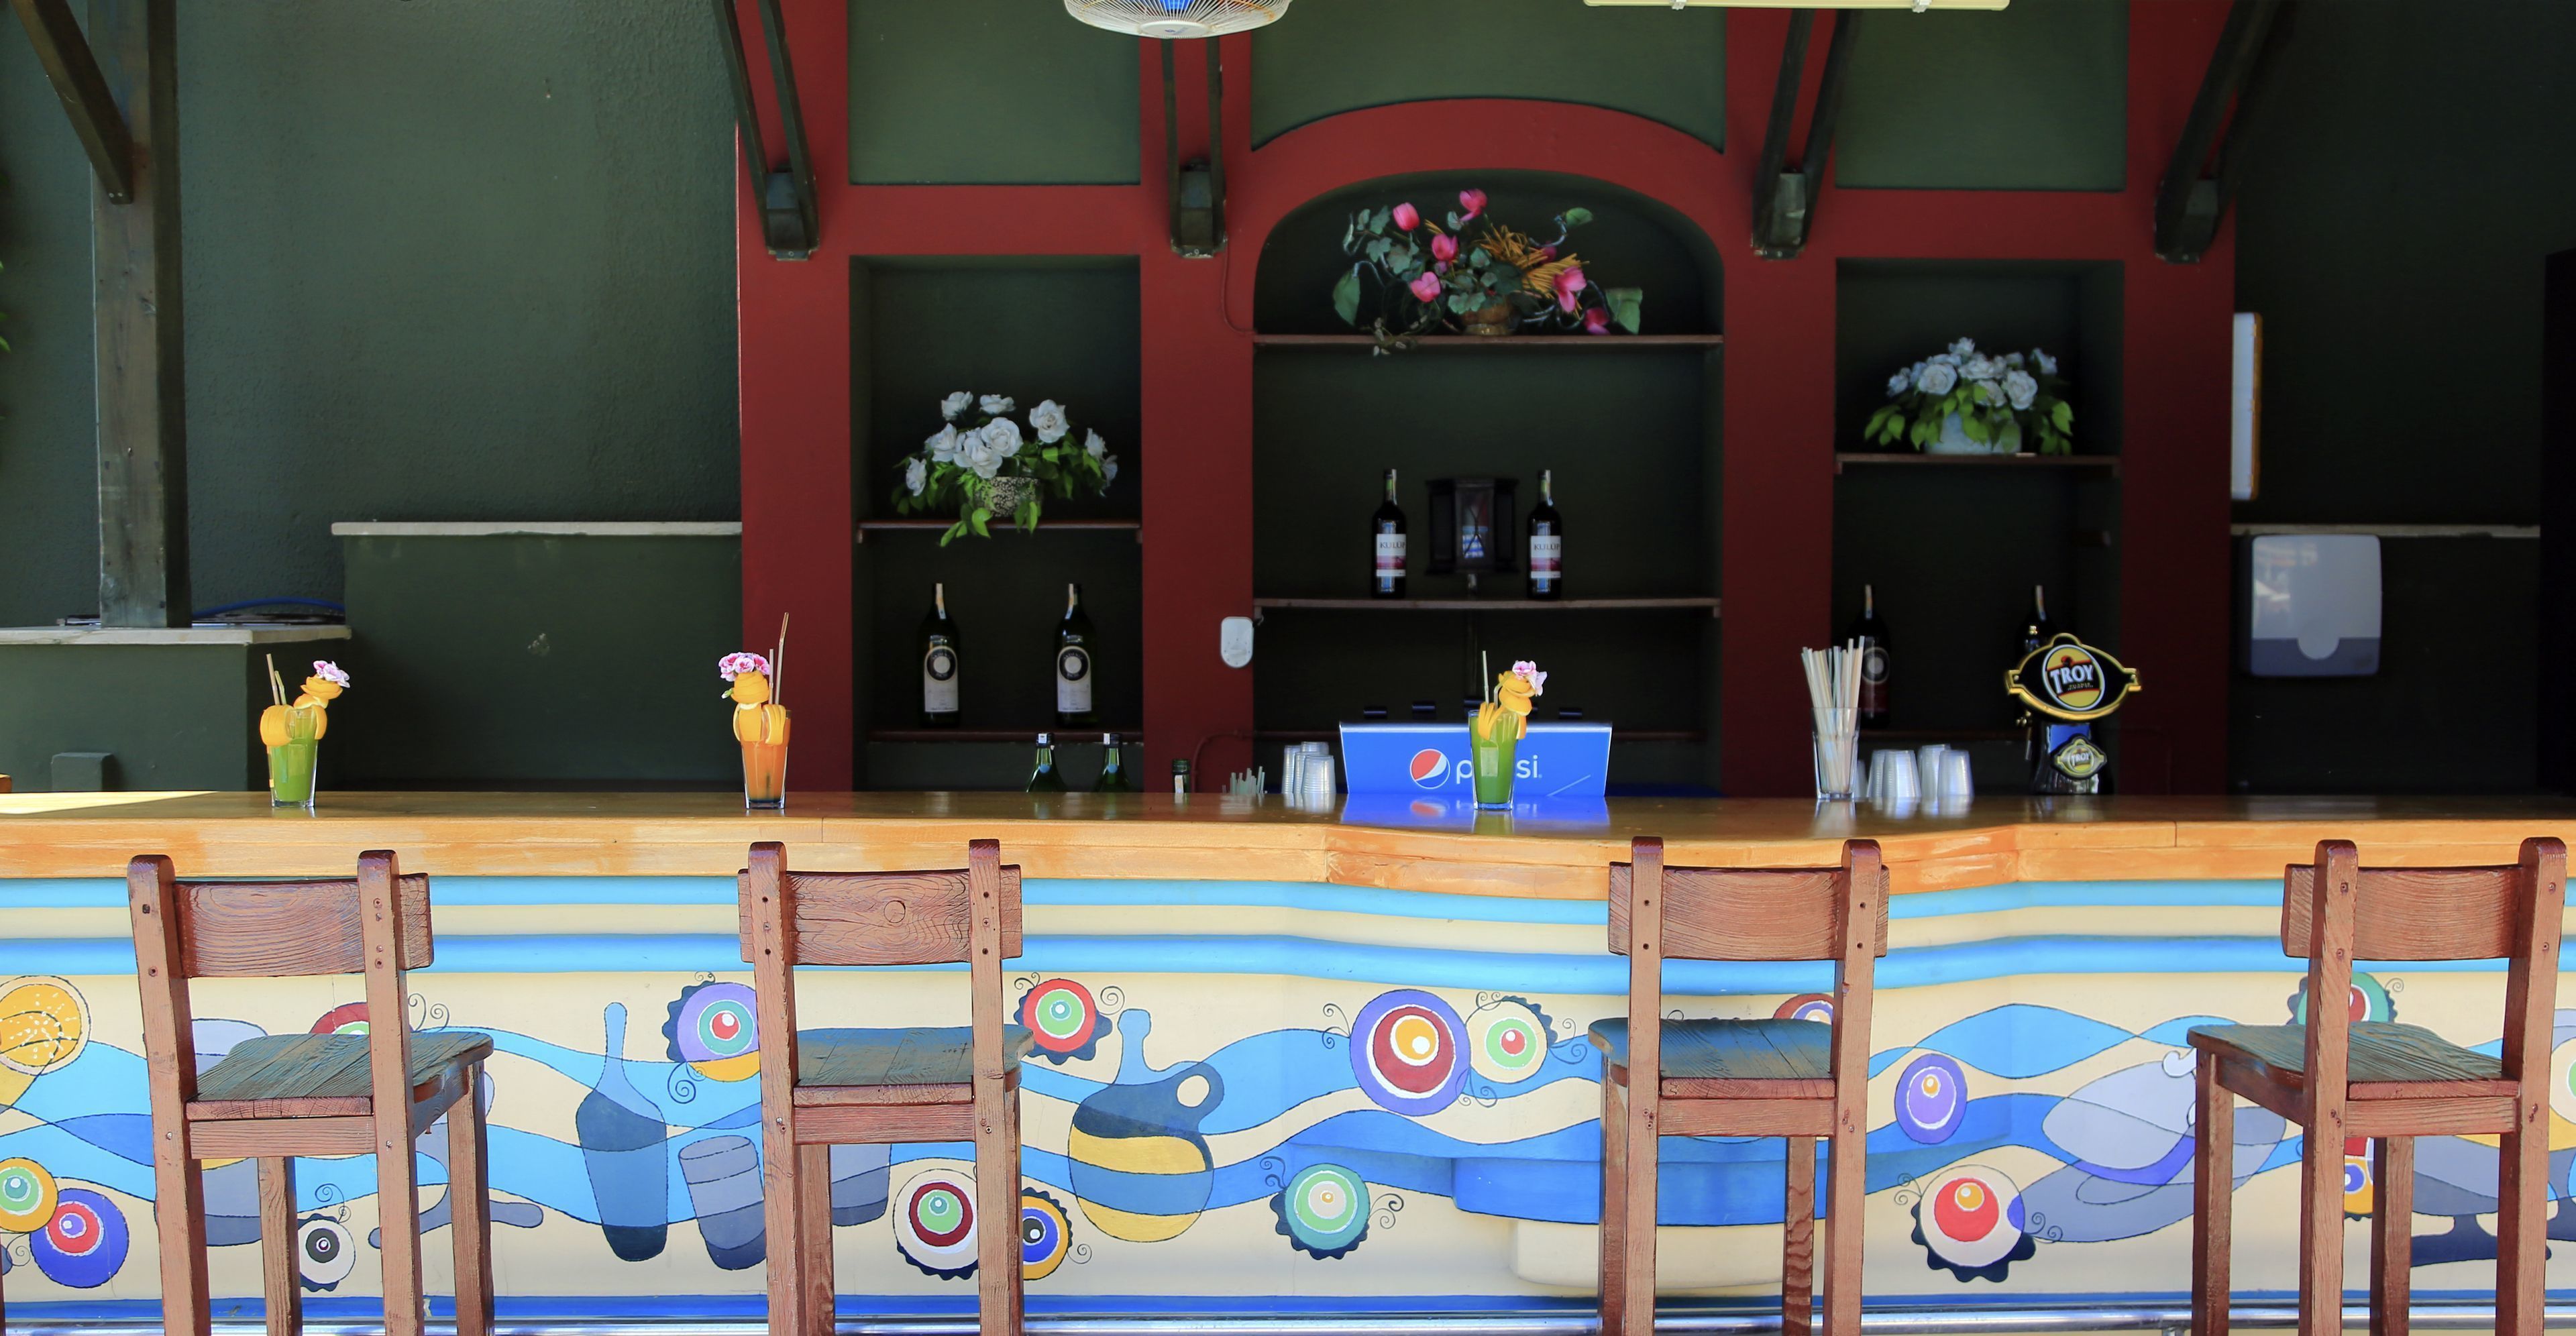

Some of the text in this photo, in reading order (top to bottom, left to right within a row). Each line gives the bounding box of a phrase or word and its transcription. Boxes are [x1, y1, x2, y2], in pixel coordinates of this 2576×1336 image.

[2049, 665, 2094, 694] TROY
[1456, 755, 1538, 785] psi
[2071, 753, 2091, 766] TROY
